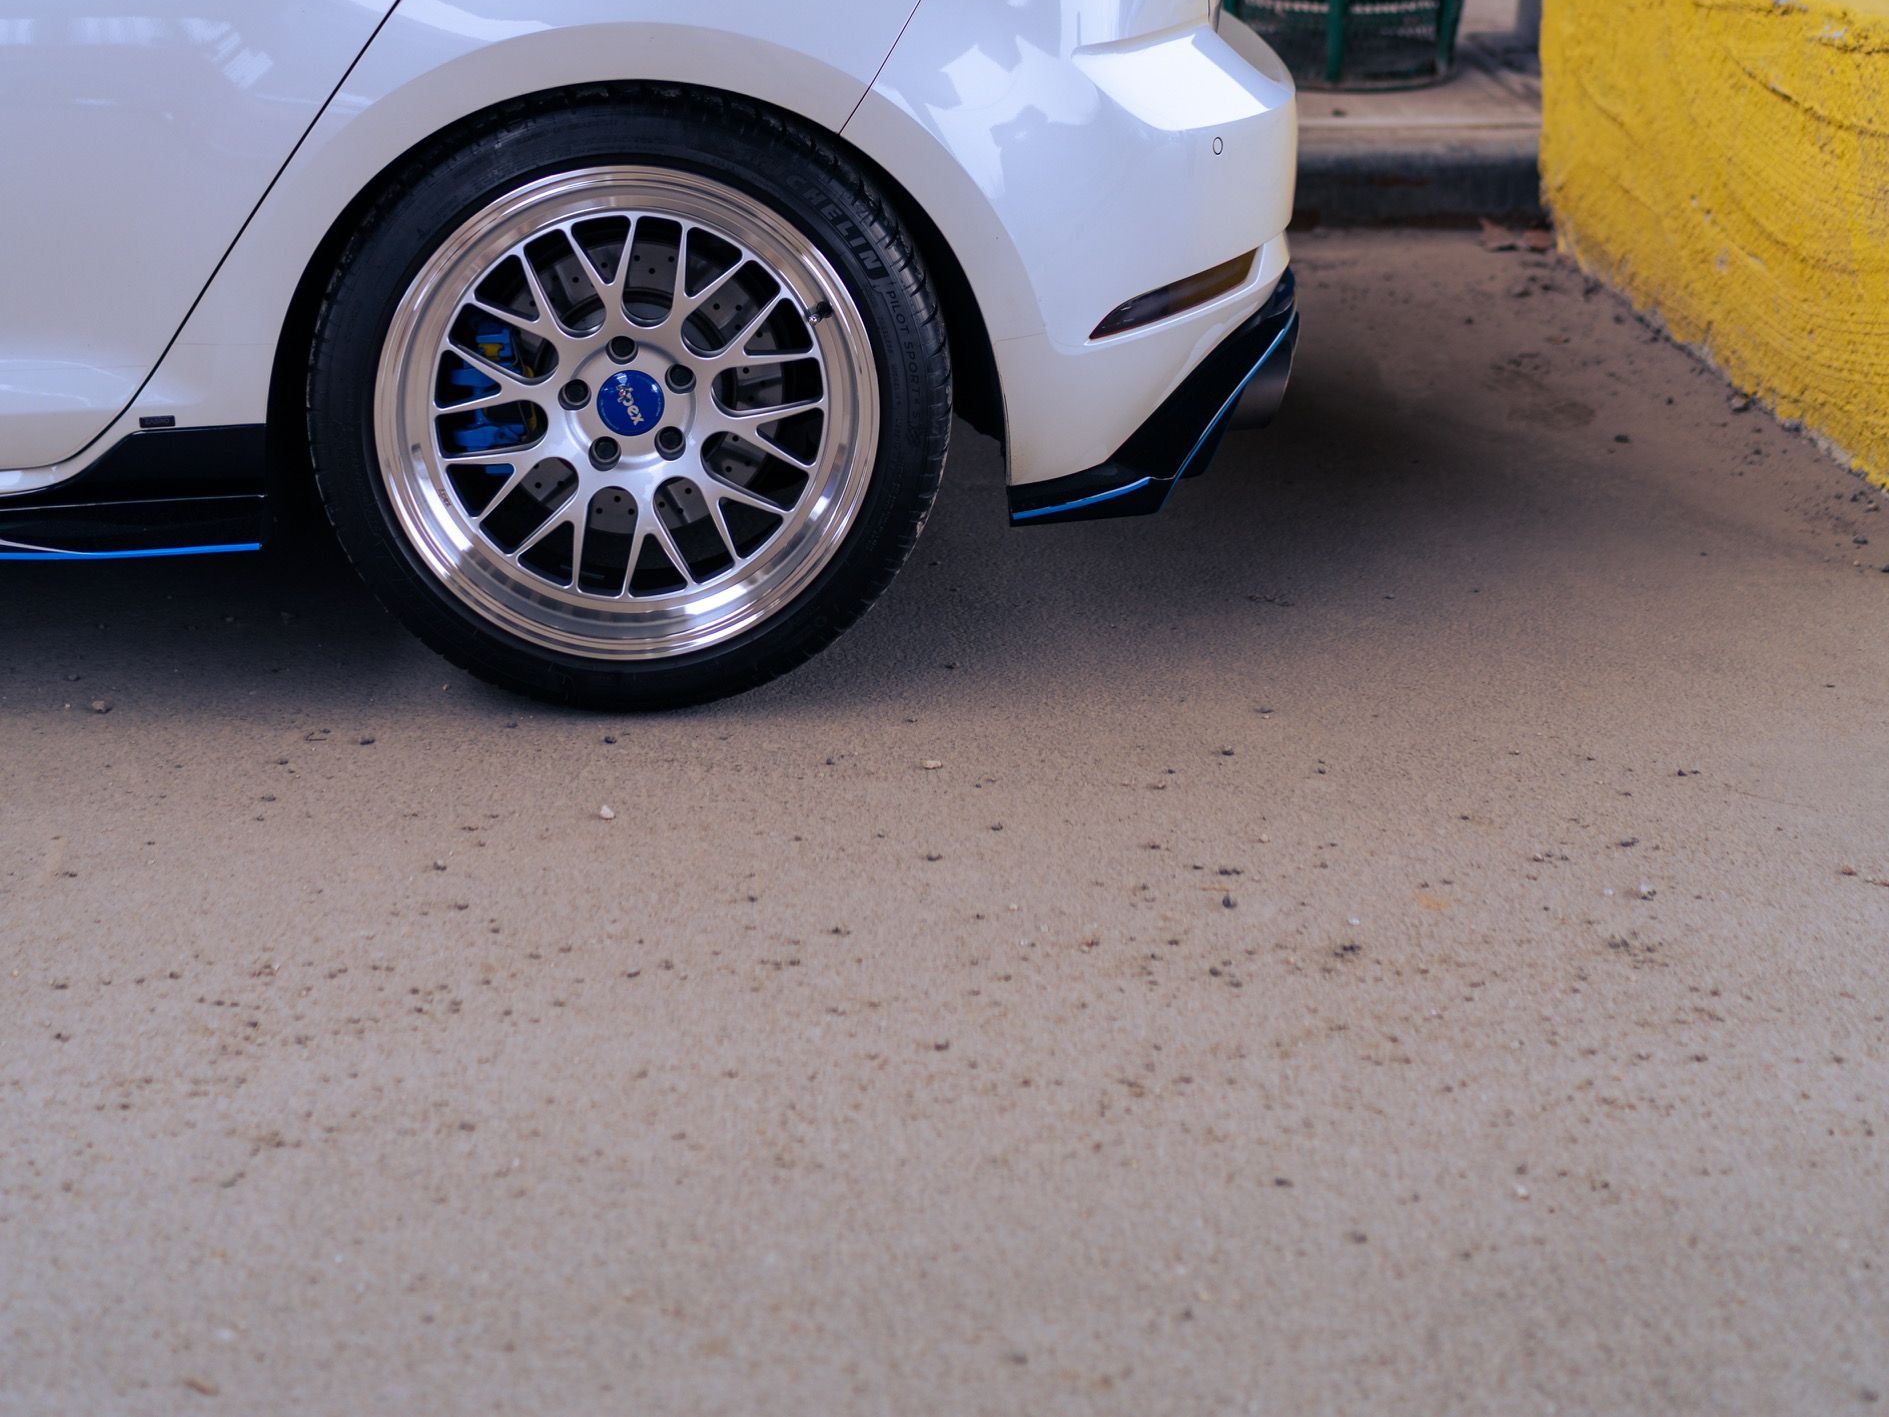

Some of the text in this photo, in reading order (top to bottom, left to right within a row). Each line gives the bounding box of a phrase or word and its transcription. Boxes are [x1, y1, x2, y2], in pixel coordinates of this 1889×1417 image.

[772, 168, 883, 274] CHELIN
[885, 290, 909, 334] PILOT
[903, 341, 921, 397] SPORT
